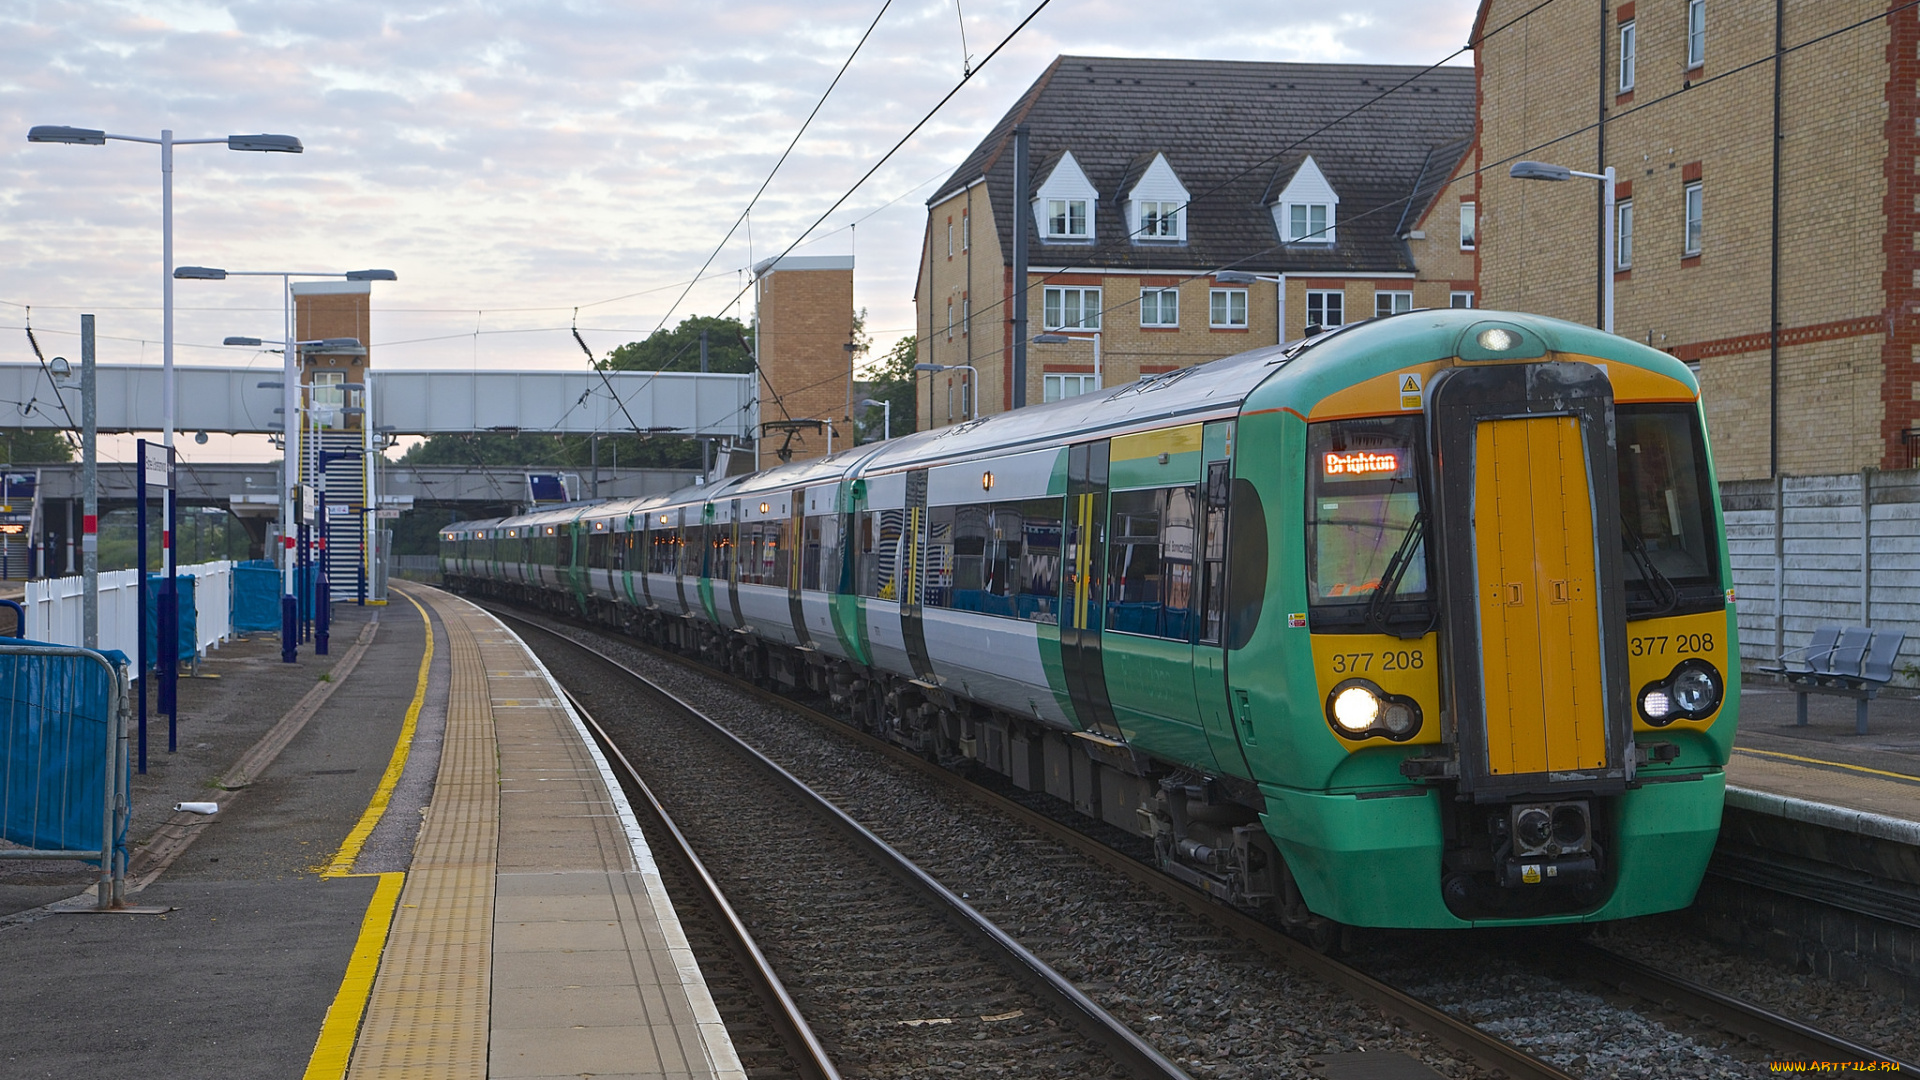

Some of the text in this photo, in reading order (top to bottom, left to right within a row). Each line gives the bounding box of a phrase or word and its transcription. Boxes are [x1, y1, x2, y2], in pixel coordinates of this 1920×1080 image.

[1326, 452, 1396, 474] Brighton
[1632, 633, 1714, 656] 377 208
[1332, 650, 1424, 673] 377 208
